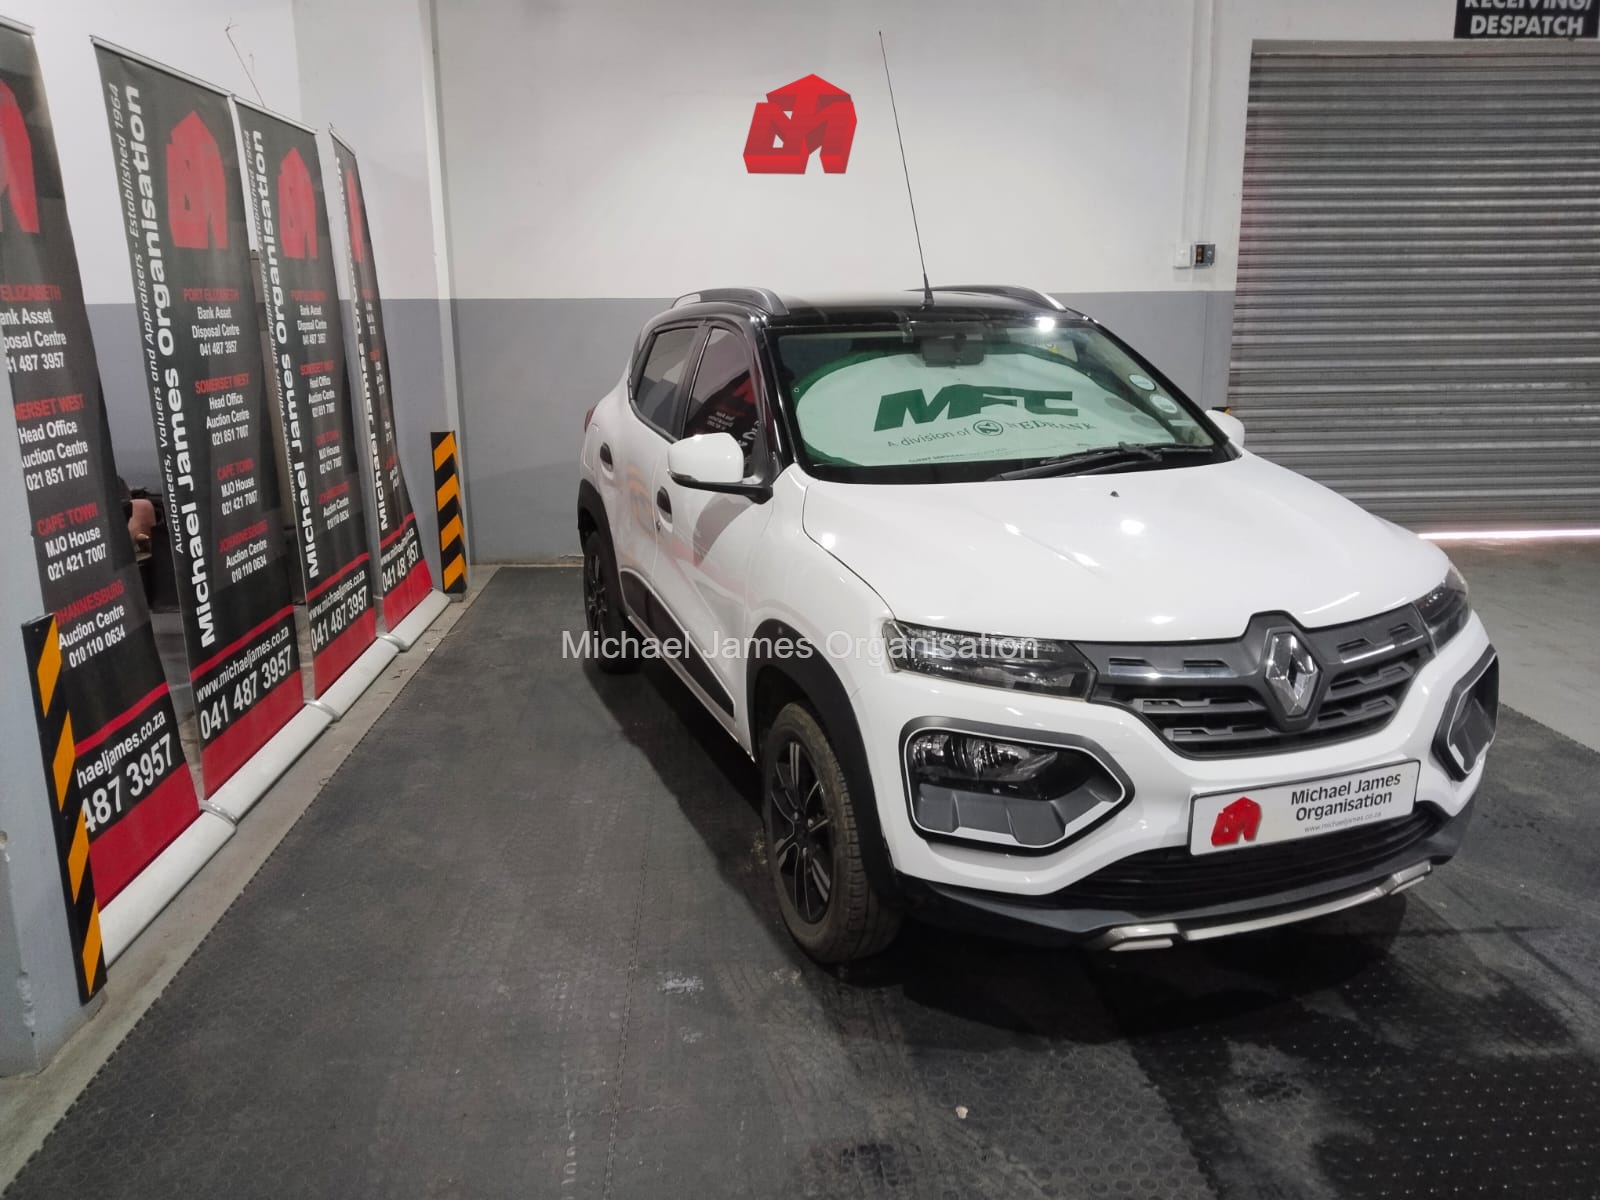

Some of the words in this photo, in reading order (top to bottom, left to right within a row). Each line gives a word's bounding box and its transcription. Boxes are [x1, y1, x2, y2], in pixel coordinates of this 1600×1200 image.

[1470, 15, 1584, 35] DESPATCH
[116, 133, 140, 238] Established
[126, 85, 174, 356] Organisation
[253, 130, 287, 344] Organisation
[21, 307, 54, 324] Asset
[134, 254, 155, 345] Appraisers
[34, 330, 67, 347] Centre
[192, 323, 221, 341] Disposal
[19, 354, 38, 371] 487
[41, 351, 64, 369] 3957
[147, 348, 159, 382] and
[152, 386, 168, 448] Valuers
[209, 394, 225, 410] Head
[225, 392, 244, 407] Office
[281, 353, 302, 453] James
[873, 384, 1078, 432] MFC
[18, 424, 46, 444] Head
[46, 419, 78, 438] Office
[164, 368, 194, 492] James
[206, 413, 231, 430] Auction
[230, 408, 250, 423] Centre
[20, 448, 56, 468] uction
[56, 440, 88, 459] Centre
[212, 431, 223, 446] 021
[223, 428, 235, 443] 851
[901, 430, 955, 448] division
[957, 427, 971, 438] of
[26, 470, 45, 491] 021
[45, 466, 65, 485] 851
[65, 459, 88, 480] 7007
[235, 477, 255, 492] House
[370, 433, 388, 531] Michael
[37, 514, 66, 536] CAPE
[68, 502, 98, 525] TOWN
[163, 454, 184, 554] Auctioneers,
[221, 499, 233, 516] 021
[294, 461, 319, 579] Michael
[45, 536, 68, 559] MJO
[68, 526, 101, 549] House
[226, 549, 248, 569] Auction
[248, 539, 268, 556] Centre
[48, 561, 65, 581] 021
[66, 552, 84, 573] 421
[85, 543, 107, 564] 7007
[181, 502, 215, 648] Michael
[382, 564, 396, 592] 041
[59, 620, 95, 650] Auction
[96, 604, 125, 628] Centre
[311, 618, 329, 652] 041
[331, 603, 346, 634] 487
[347, 585, 367, 619] 3957
[69, 646, 87, 668] 010
[87, 635, 104, 658] 110
[105, 623, 126, 647] 0634
[196, 625, 290, 703] www.michaeljames.co.za
[200, 694, 230, 740] 041
[233, 670, 258, 713] 487
[261, 644, 292, 689] 3957
[76, 711, 166, 789] haeljames.co.za
[82, 775, 122, 833] 487
[126, 732, 172, 797] 3957
[1290, 781, 1351, 806] Michael
[1354, 773, 1401, 794] James
[1296, 791, 1392, 822] Organisation
